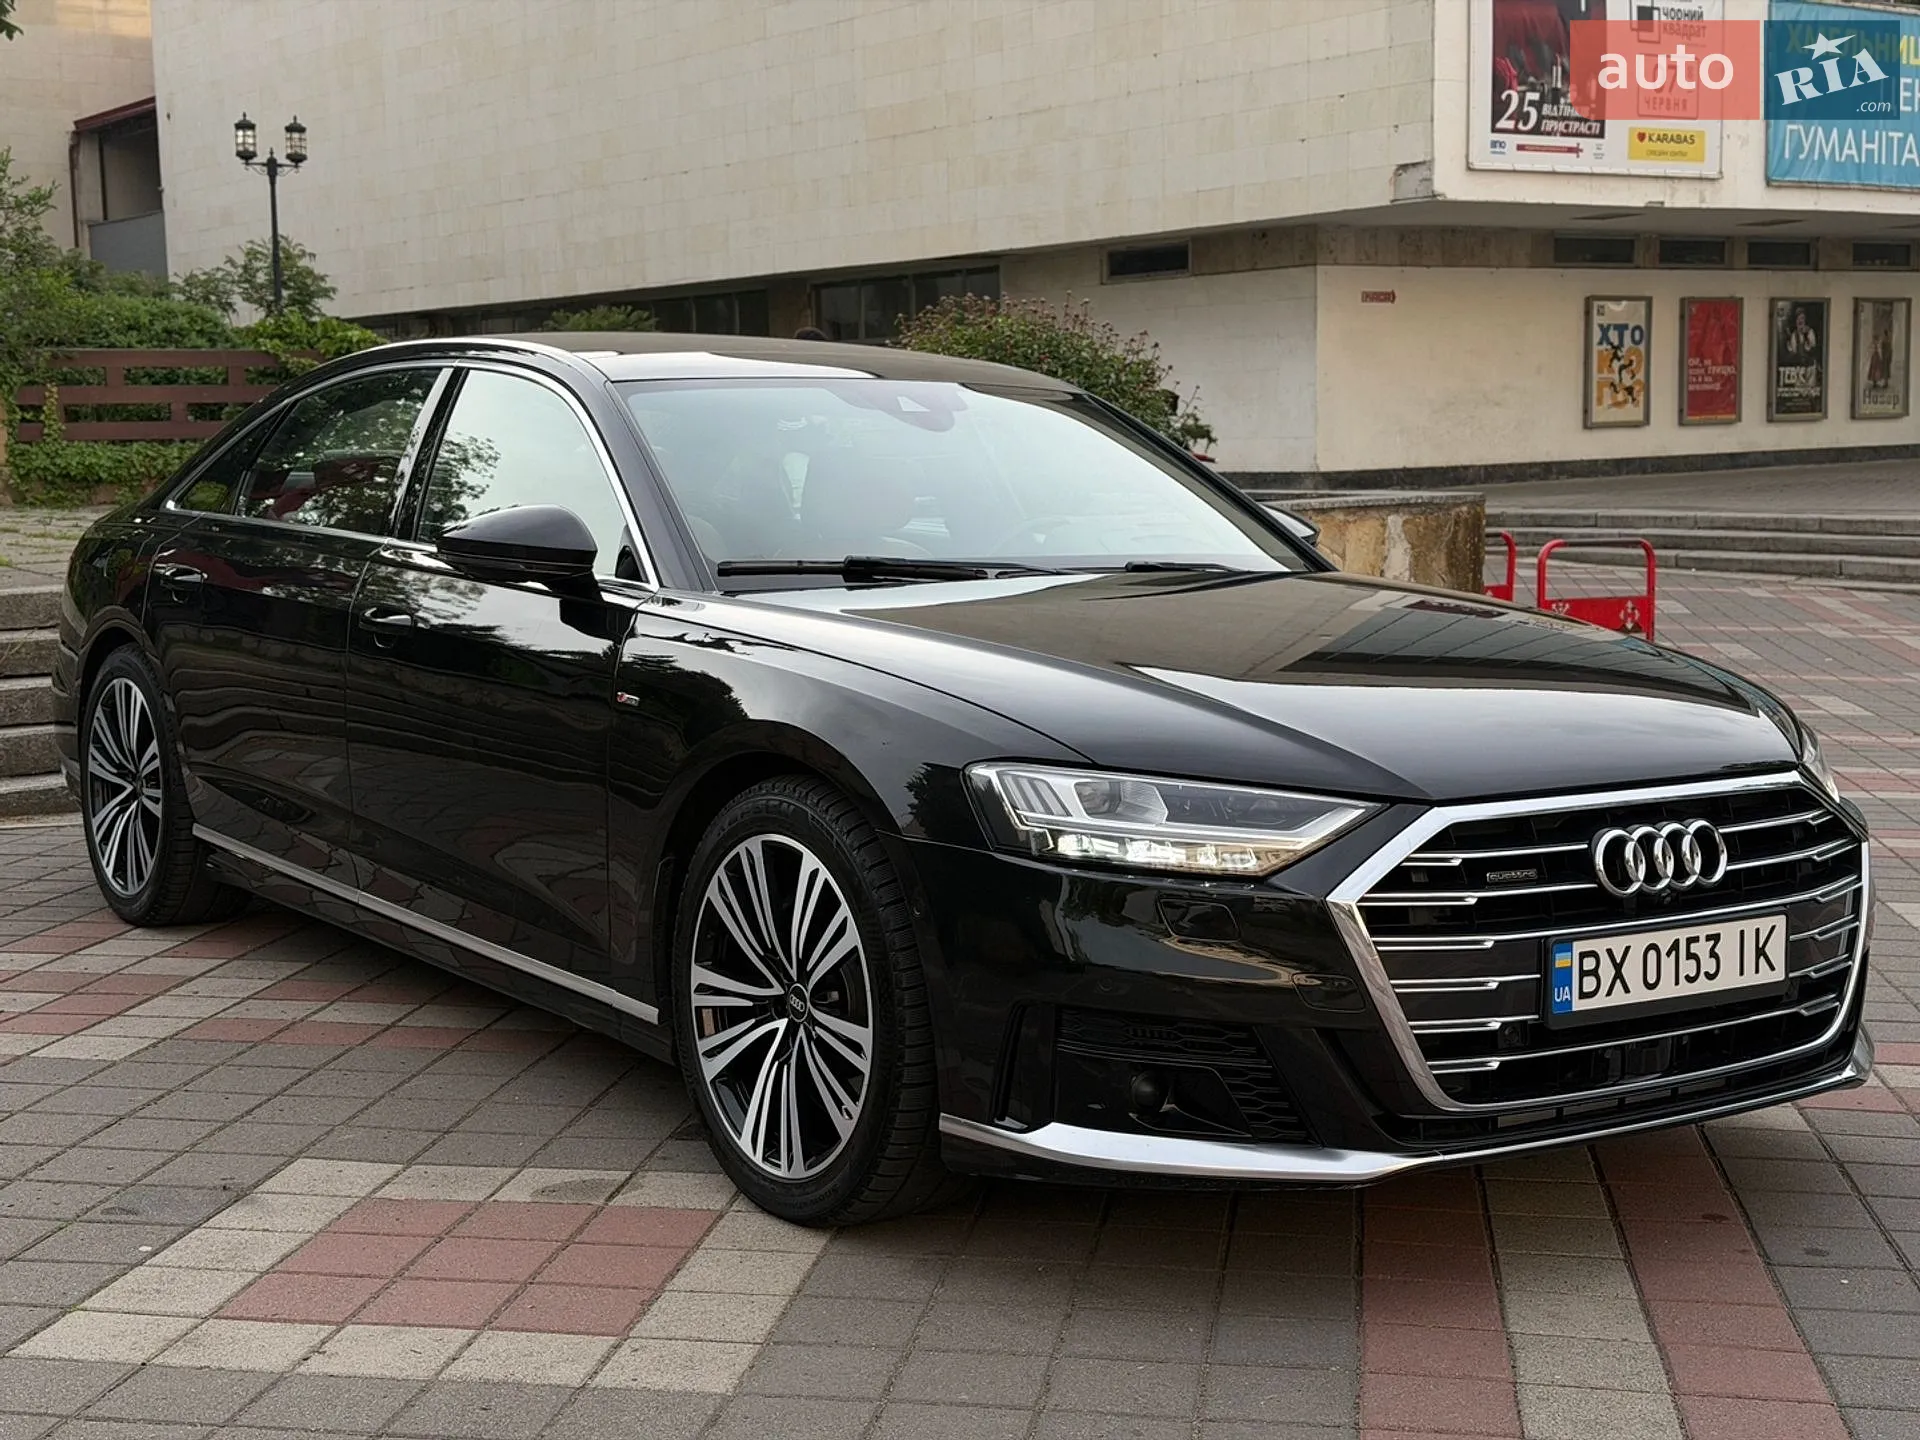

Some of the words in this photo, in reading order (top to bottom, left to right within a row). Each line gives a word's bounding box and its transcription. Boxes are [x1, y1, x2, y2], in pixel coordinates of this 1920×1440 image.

[1495, 90, 1541, 132] 25
[1648, 133, 1696, 145] KARABAS
[1784, 124, 1920, 168] ГУМАНІТА
[1597, 323, 1645, 347] ХТО
[1578, 945, 1631, 1000] BX
[1642, 932, 1721, 991] 0153
[1739, 924, 1777, 977] IK
[1554, 986, 1571, 1003] UA
